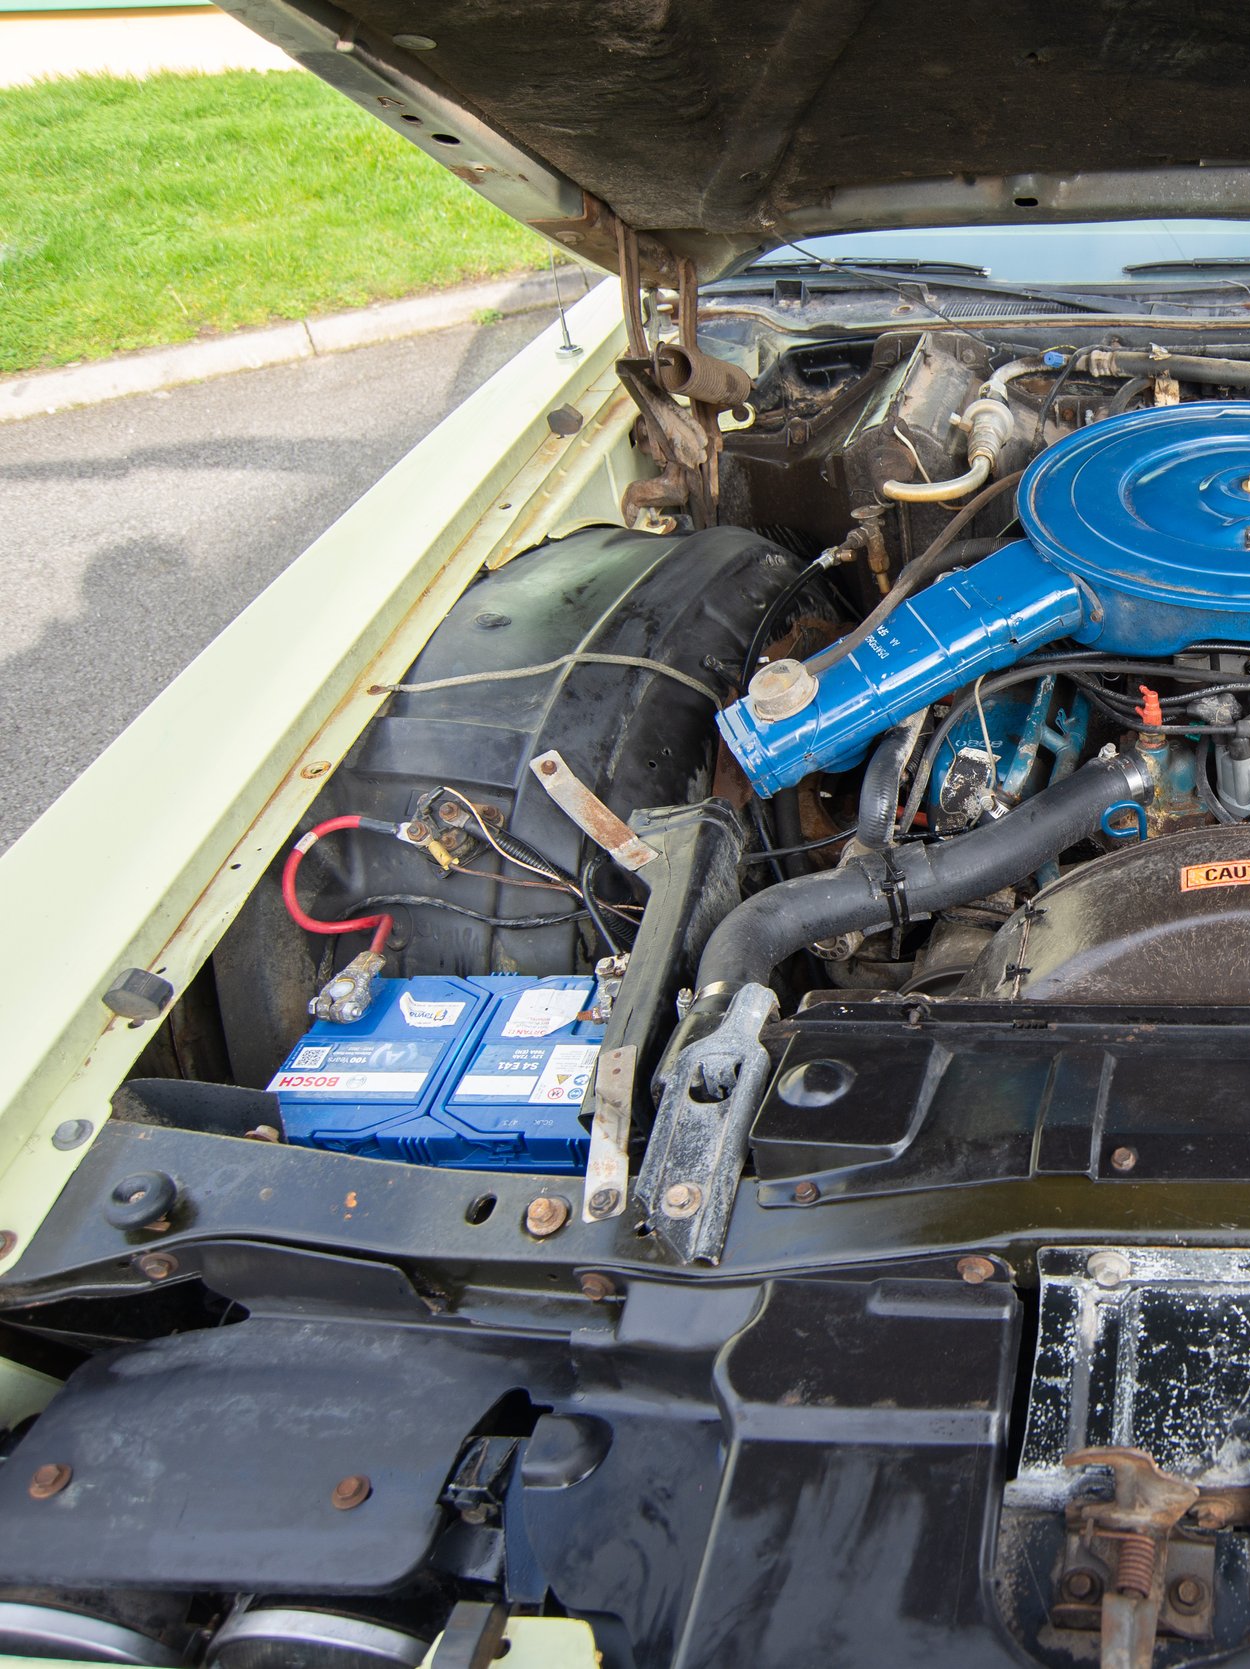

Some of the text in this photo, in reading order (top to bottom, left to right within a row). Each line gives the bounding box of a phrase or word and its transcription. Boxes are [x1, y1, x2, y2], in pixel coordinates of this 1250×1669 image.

[1201, 685, 1225, 694] STATIC
[409, 1011, 434, 1019] Tayna
[328, 1056, 350, 1064] Years
[497, 1061, 540, 1070] S4 E41
[278, 1076, 340, 1087] BOSCH
